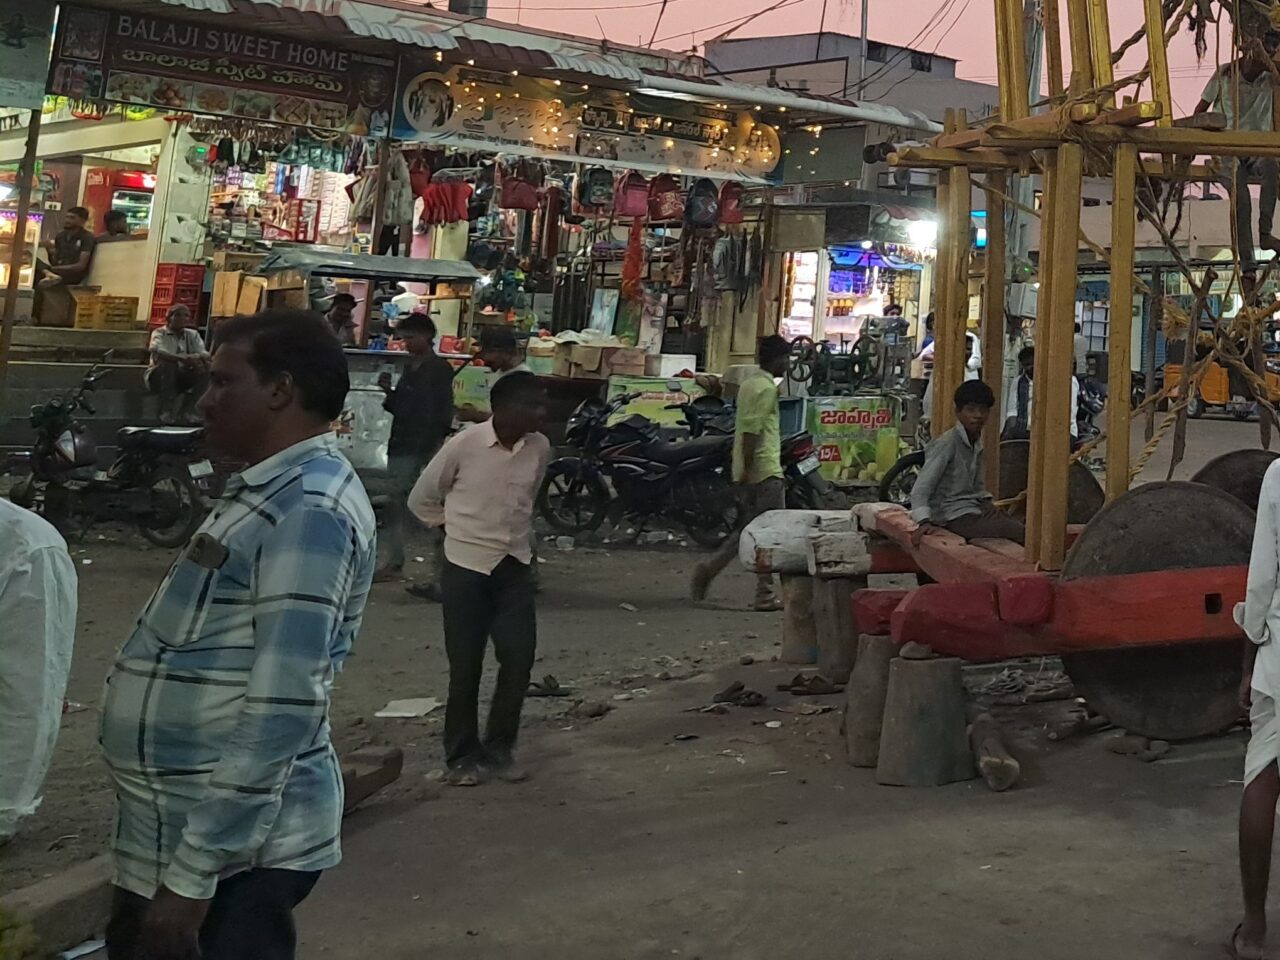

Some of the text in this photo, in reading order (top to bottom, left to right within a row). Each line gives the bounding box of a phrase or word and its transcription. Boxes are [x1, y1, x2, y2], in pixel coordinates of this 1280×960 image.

[117, 15, 199, 47] BALAJI
[204, 33, 281, 60] SWEET
[287, 42, 349, 72] HOME
[820, 447, 839, 461] 15/-
